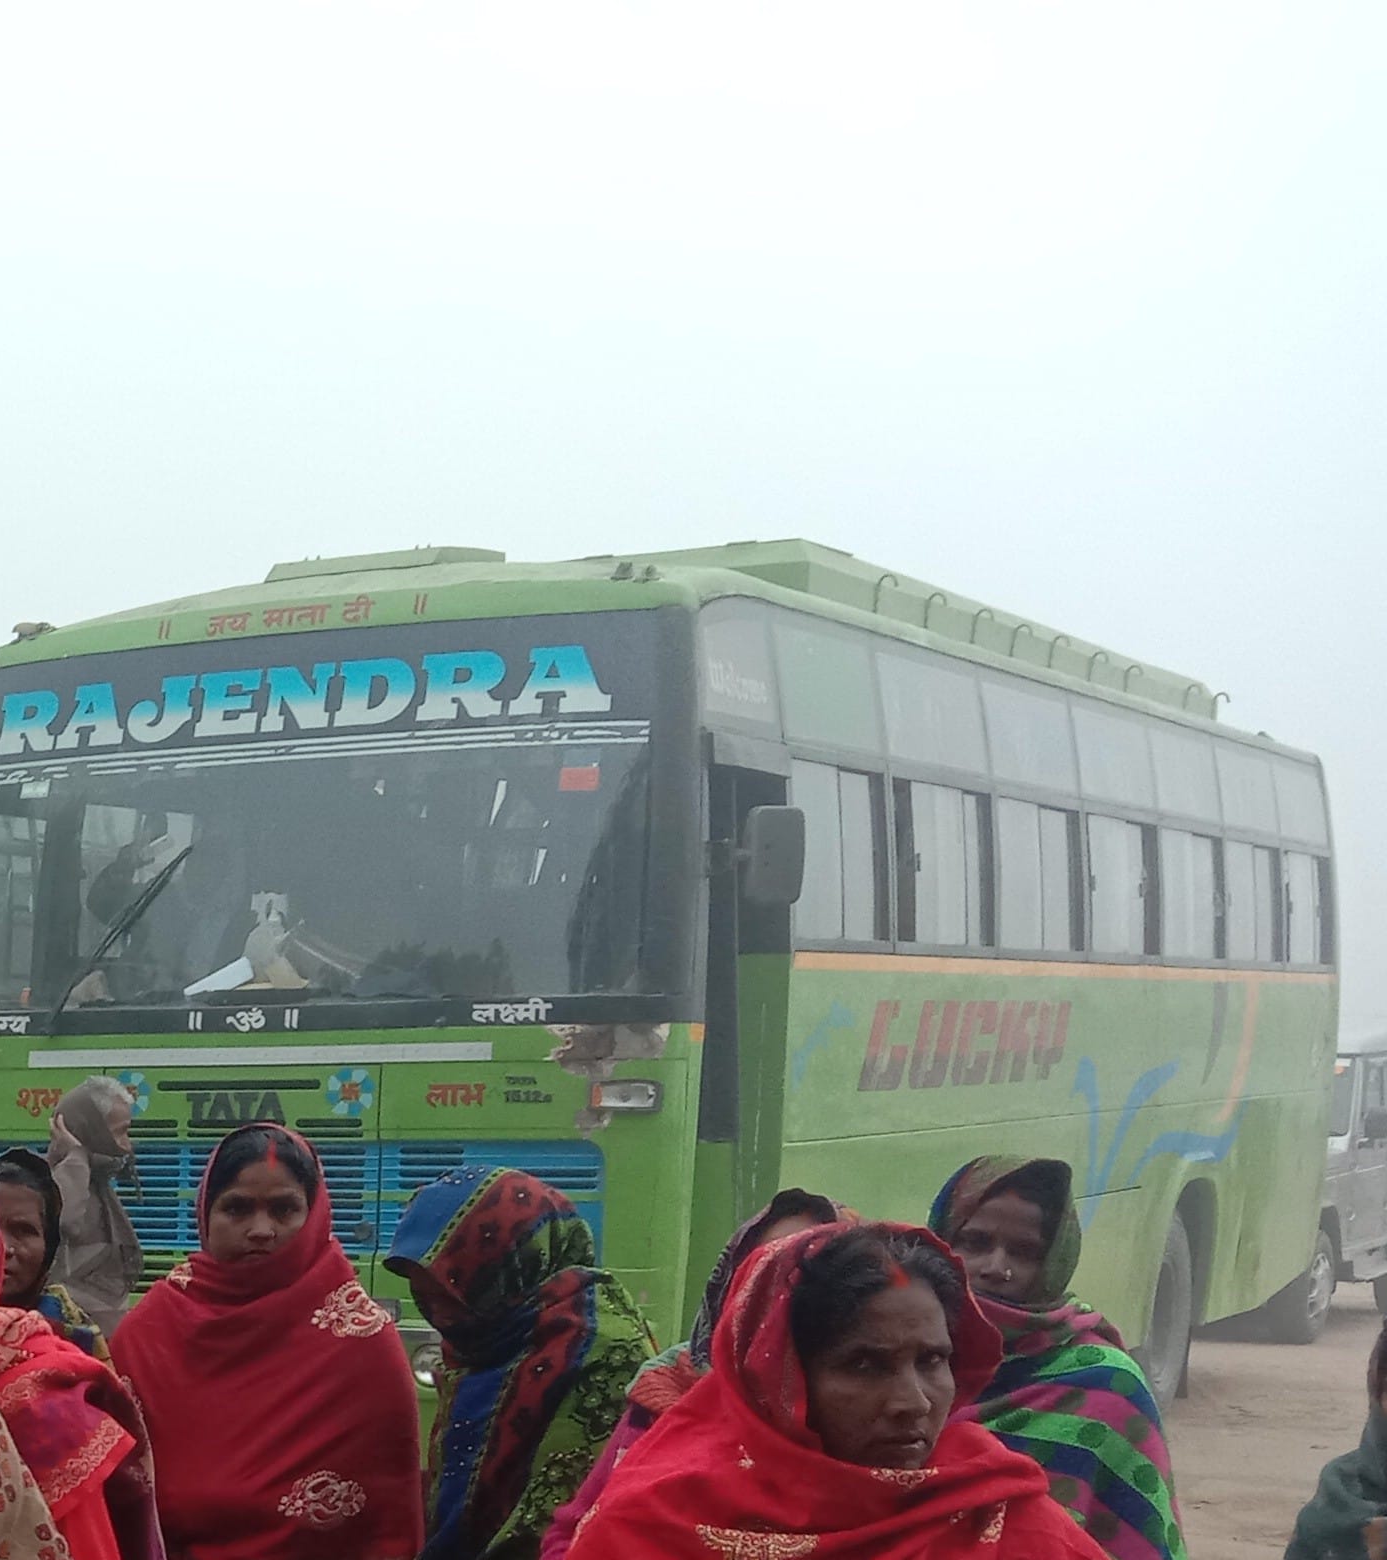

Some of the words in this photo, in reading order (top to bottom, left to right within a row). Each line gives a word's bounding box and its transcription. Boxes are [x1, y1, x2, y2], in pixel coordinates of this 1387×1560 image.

[206, 611, 251, 638] जय
[263, 603, 331, 628] माता
[341, 593, 375, 624] दी
[471, 998, 554, 1024] लक्ष्मी
[857, 1000, 1072, 1090] LUCKY
[186, 1091, 287, 1128] TATA
[426, 1083, 487, 1108] लाभ
